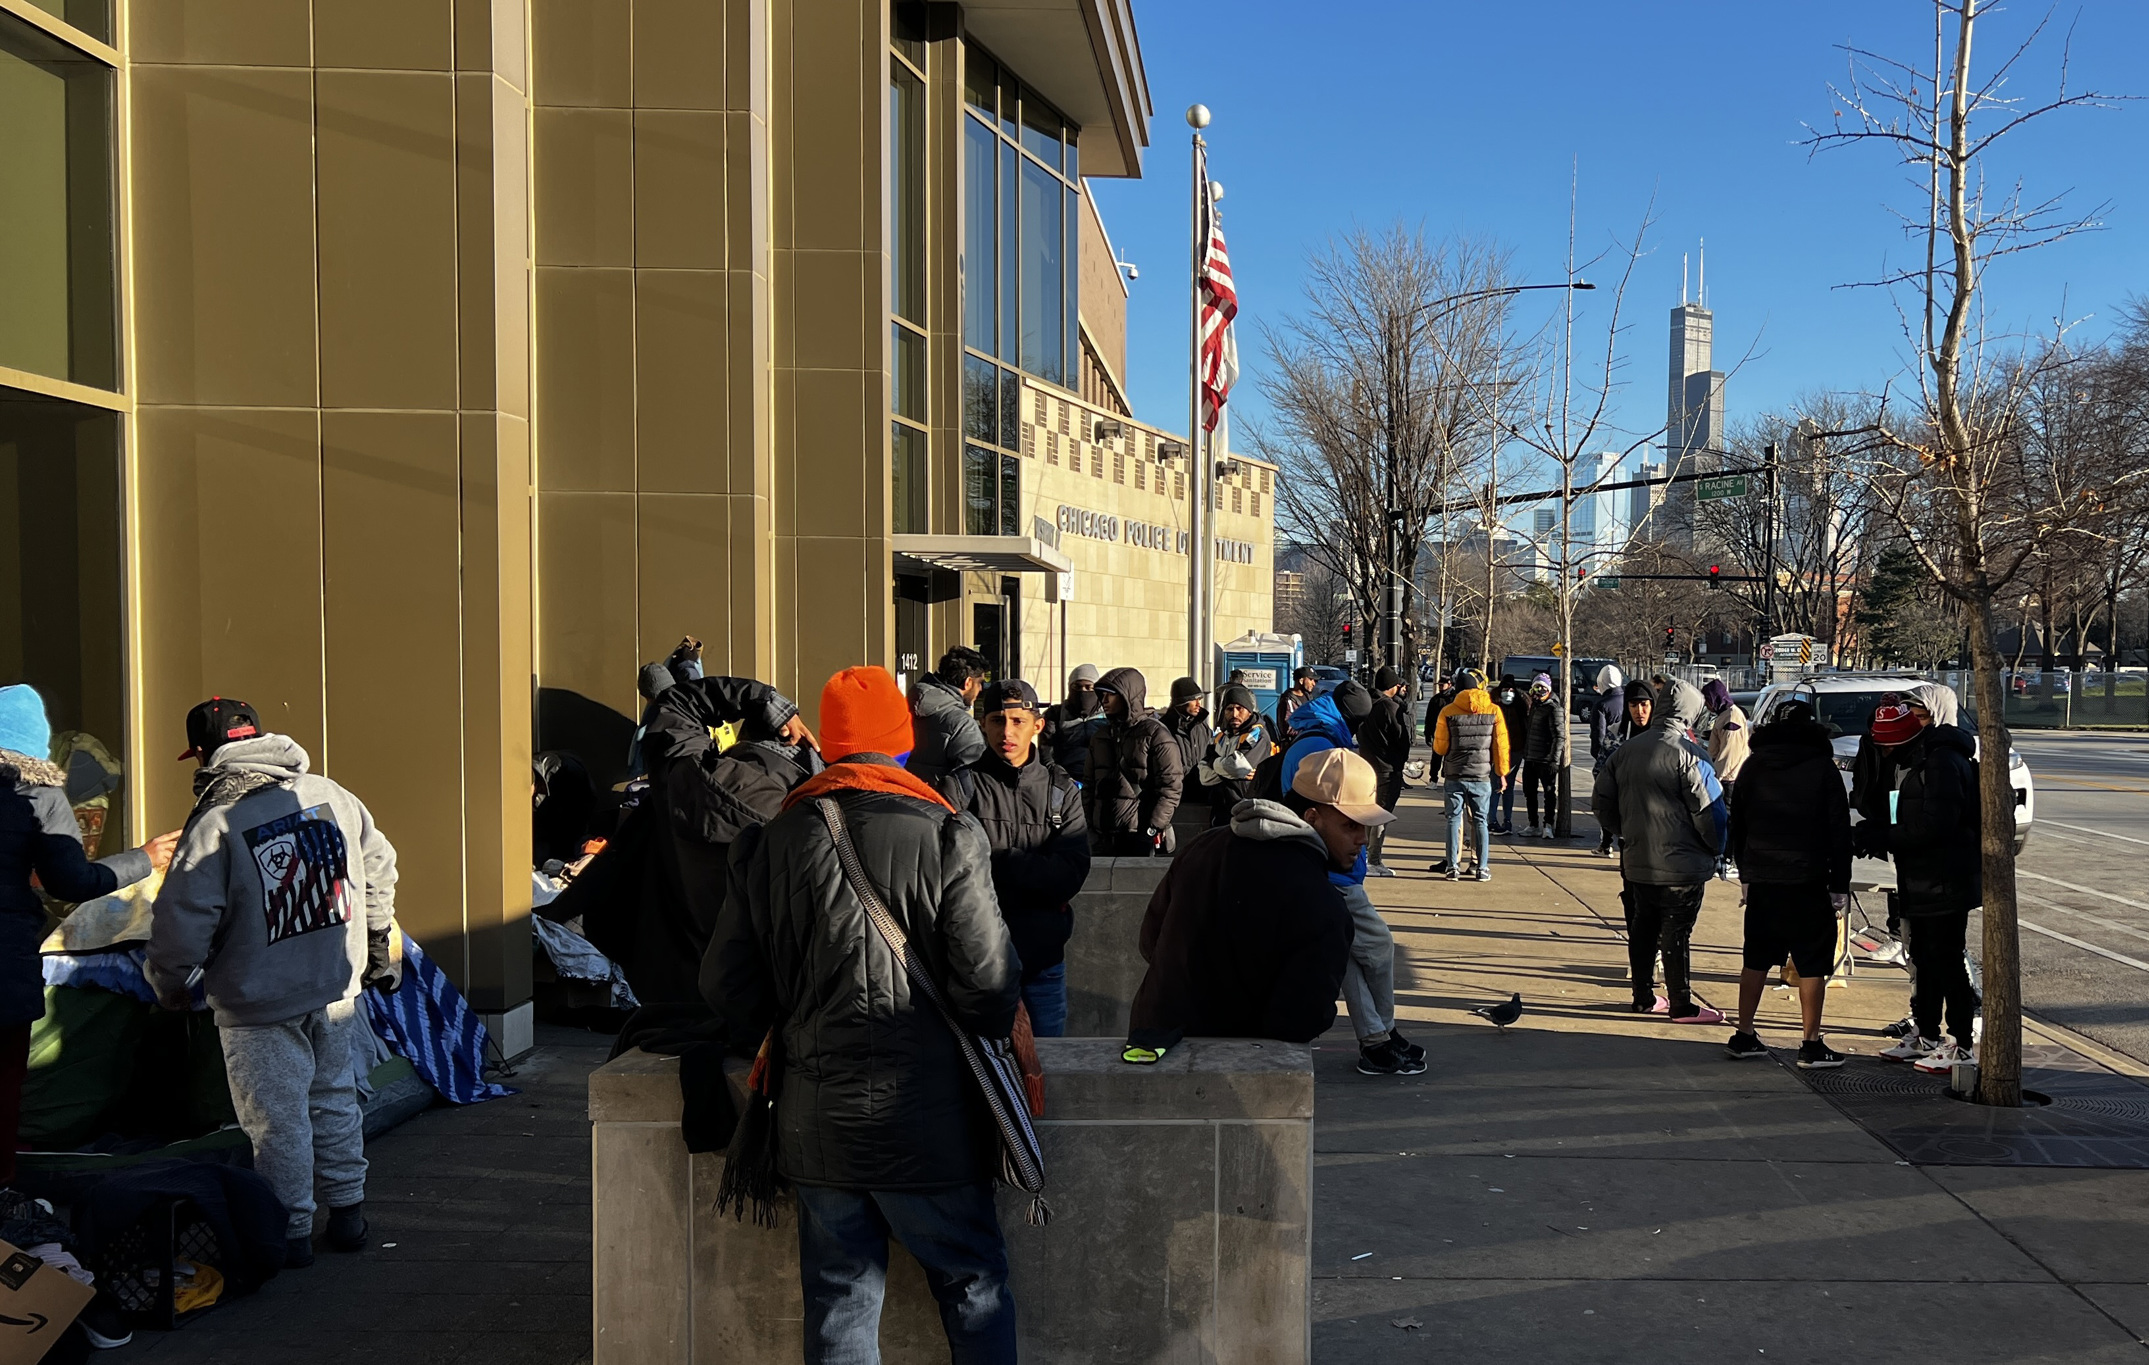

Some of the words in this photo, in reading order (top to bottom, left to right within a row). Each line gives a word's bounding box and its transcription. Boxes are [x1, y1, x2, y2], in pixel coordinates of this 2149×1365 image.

[1705, 480, 1735, 490] RACINE
[1057, 504, 1119, 541] CHICAGO
[1124, 519, 1171, 552] POLICE
[901, 653, 918, 670] 1412
[1813, 654, 1827, 662] 20
[1243, 670, 1272, 679] Service
[257, 806, 321, 841] ARIAT
